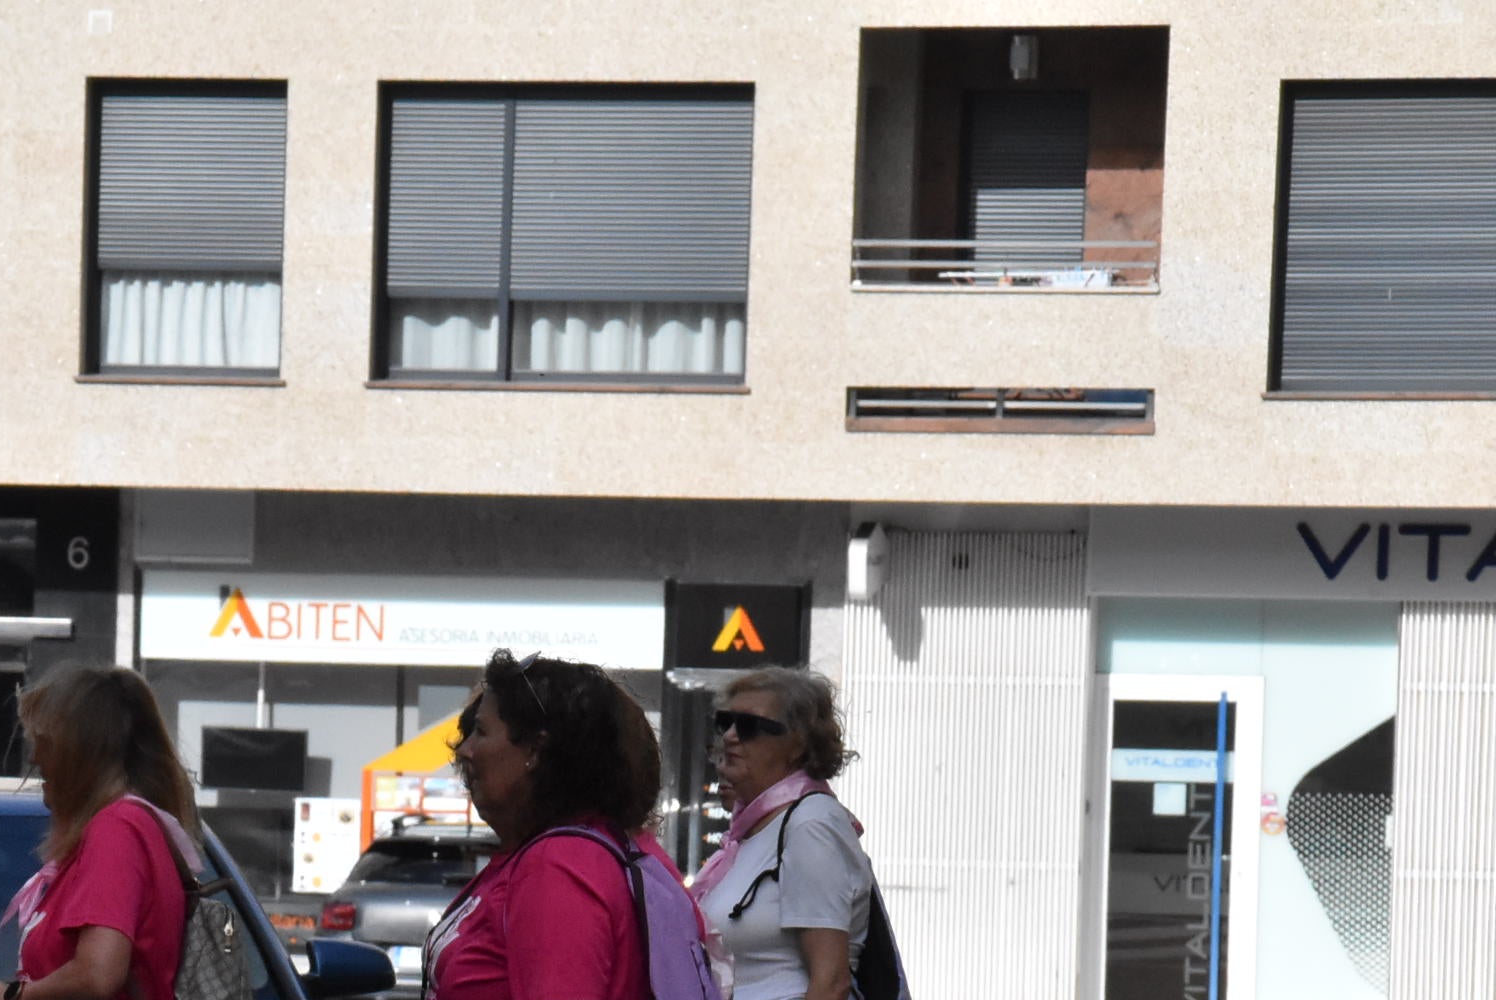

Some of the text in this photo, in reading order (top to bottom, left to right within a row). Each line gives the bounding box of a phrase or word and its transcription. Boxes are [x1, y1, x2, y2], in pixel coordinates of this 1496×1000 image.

[67, 536, 89, 569] 6
[209, 587, 384, 642] ABITEN
[398, 626, 481, 645] ASESORIA
